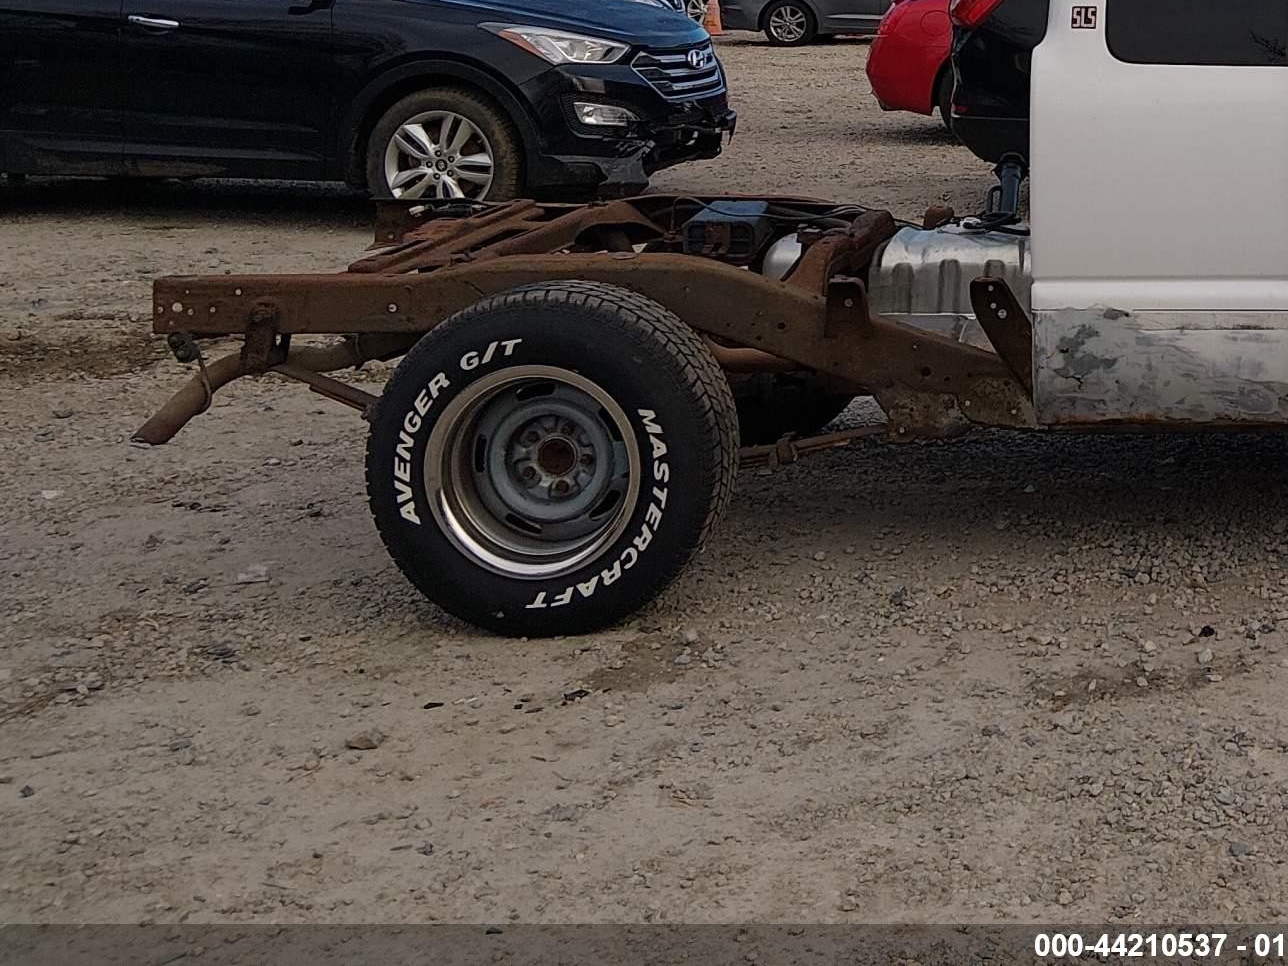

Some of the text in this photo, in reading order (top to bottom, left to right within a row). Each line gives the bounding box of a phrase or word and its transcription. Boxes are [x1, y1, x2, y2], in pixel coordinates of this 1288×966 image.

[1071, 6, 1097, 28] SLS
[393, 338, 522, 525] AVENGER G/T
[524, 408, 670, 609] MASTERCRAFT
